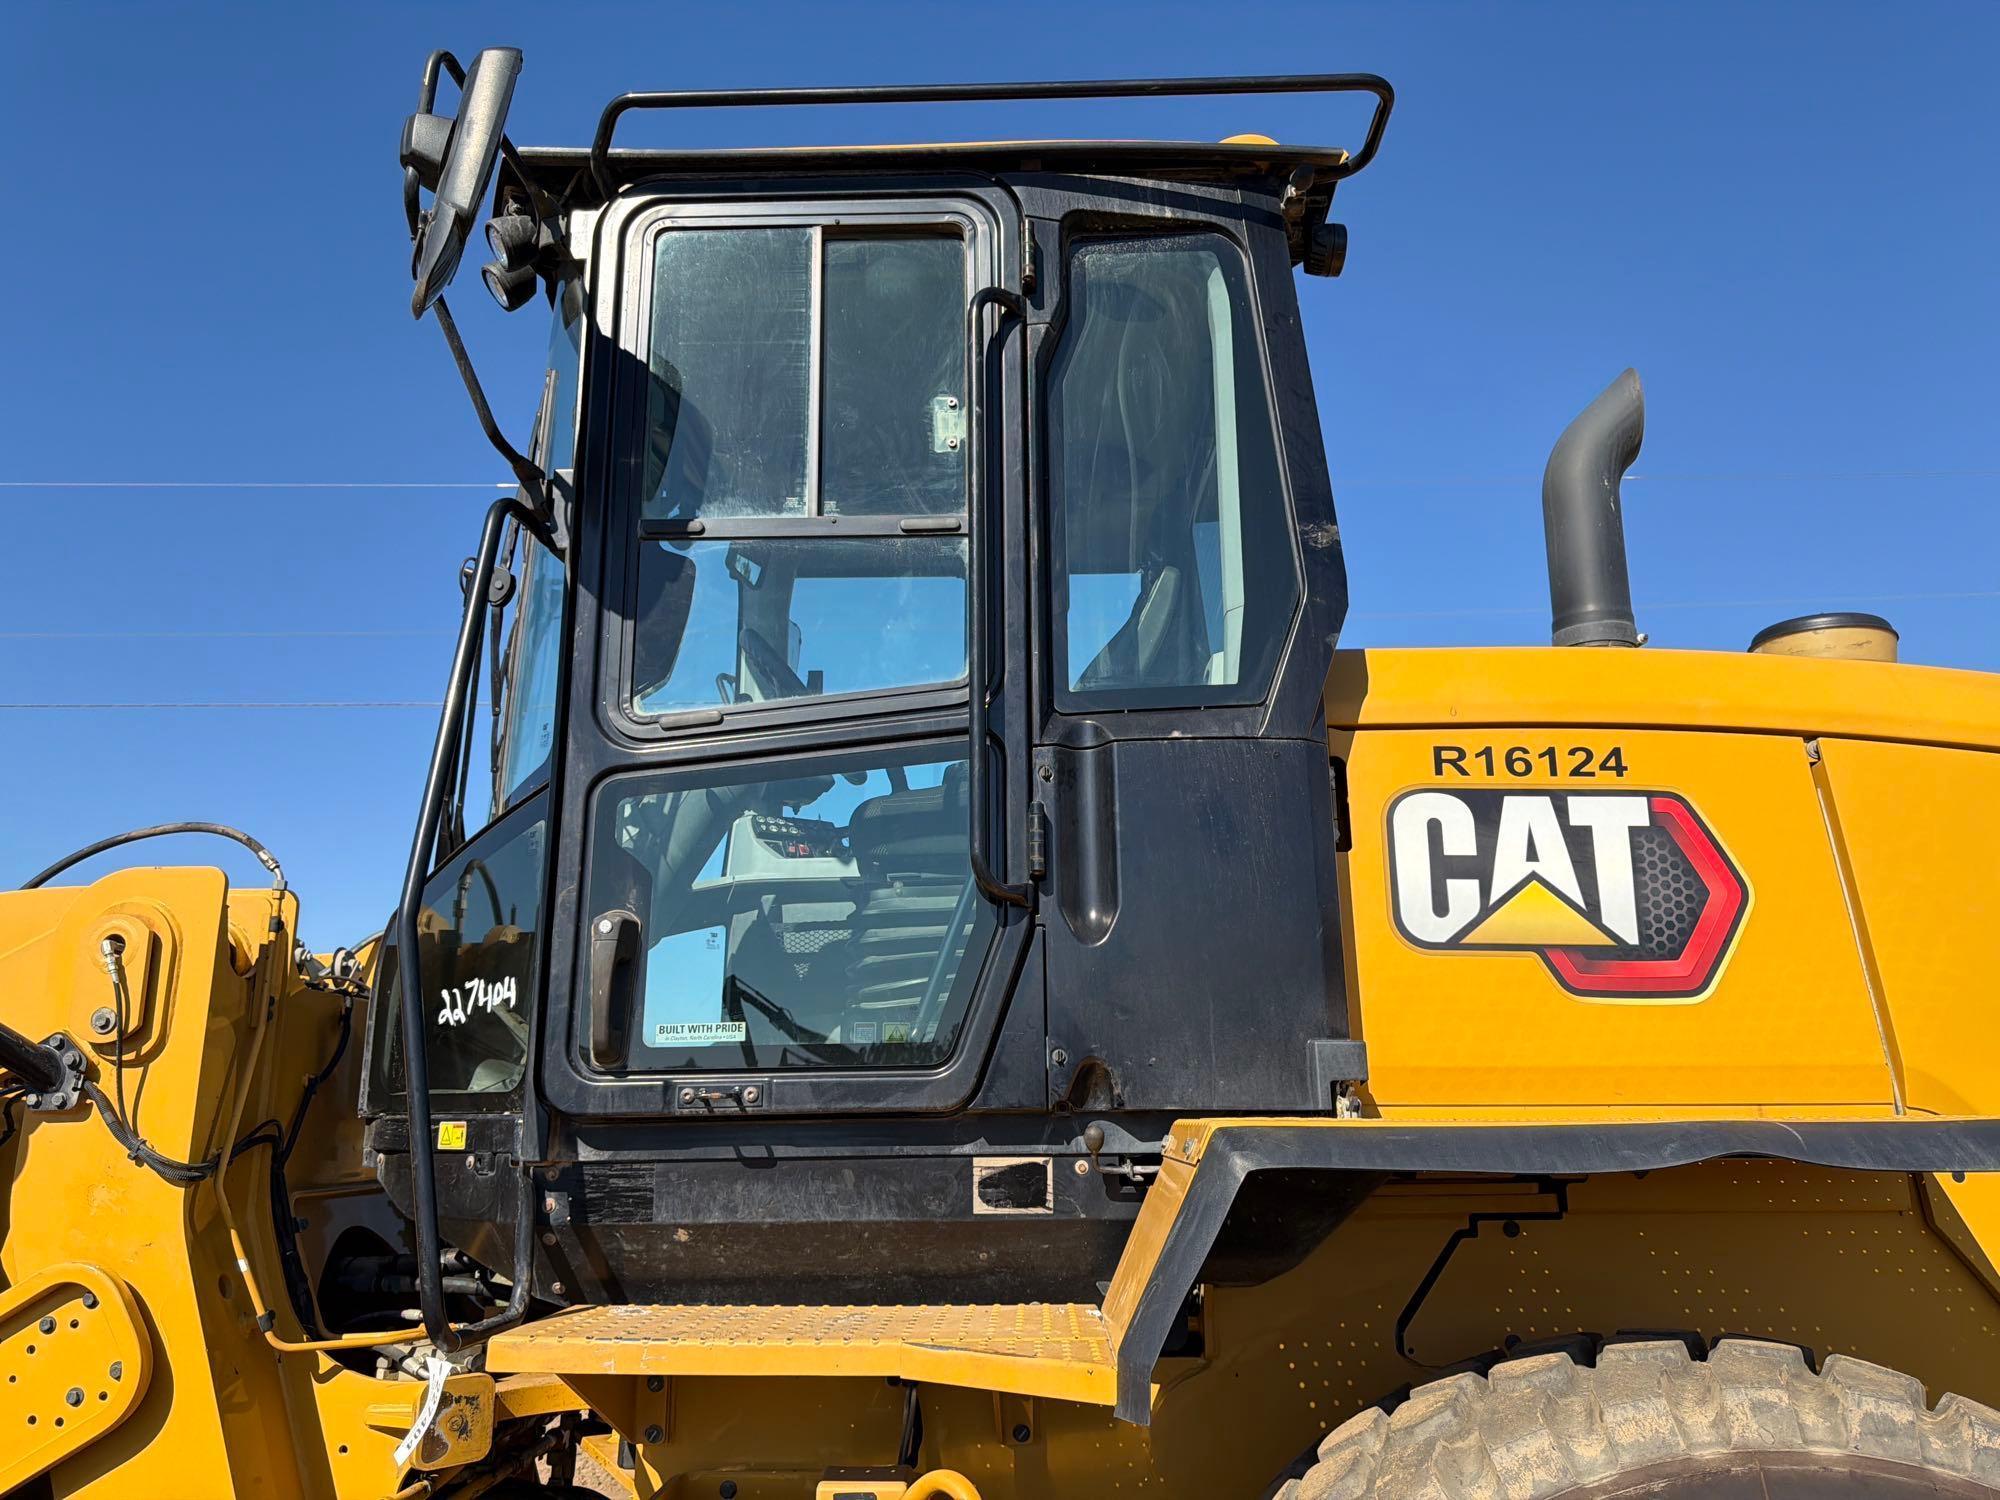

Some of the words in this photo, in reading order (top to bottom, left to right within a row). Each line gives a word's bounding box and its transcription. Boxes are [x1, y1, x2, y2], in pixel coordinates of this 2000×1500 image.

[1432, 746, 1629, 778] R16124
[1393, 792, 1651, 946] CAT
[438, 976, 517, 1027] 227404
[658, 1025, 686, 1035] BUILT
[688, 1024, 713, 1034] WITH
[715, 1023, 743, 1033] PRIDE
